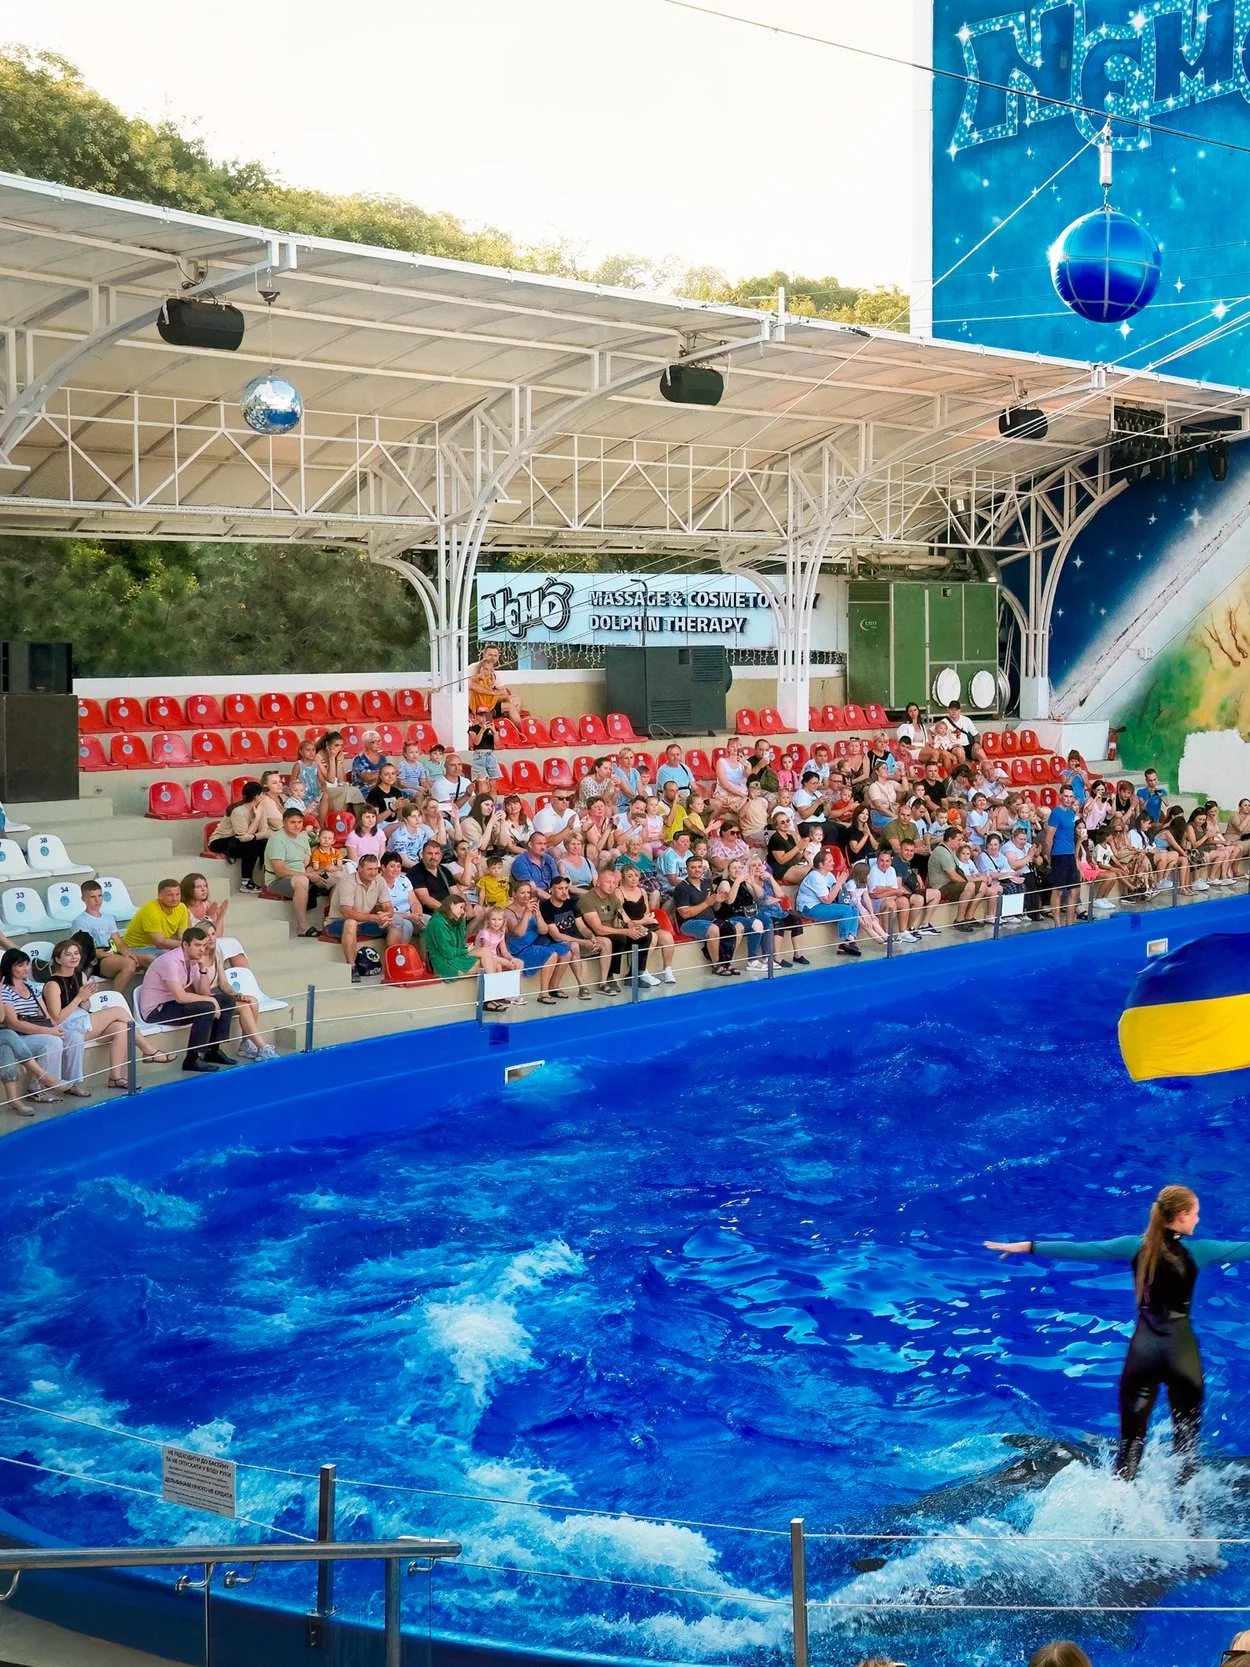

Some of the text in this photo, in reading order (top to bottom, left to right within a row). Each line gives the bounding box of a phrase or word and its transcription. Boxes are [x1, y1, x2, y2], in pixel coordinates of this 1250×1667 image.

[589, 591, 666, 607] MASSAGE
[589, 615, 746, 633] DOLPHN THERAPY
[30, 949, 40, 958] 29
[230, 971, 238, 979] 29
[99, 994, 109, 1003] 26
